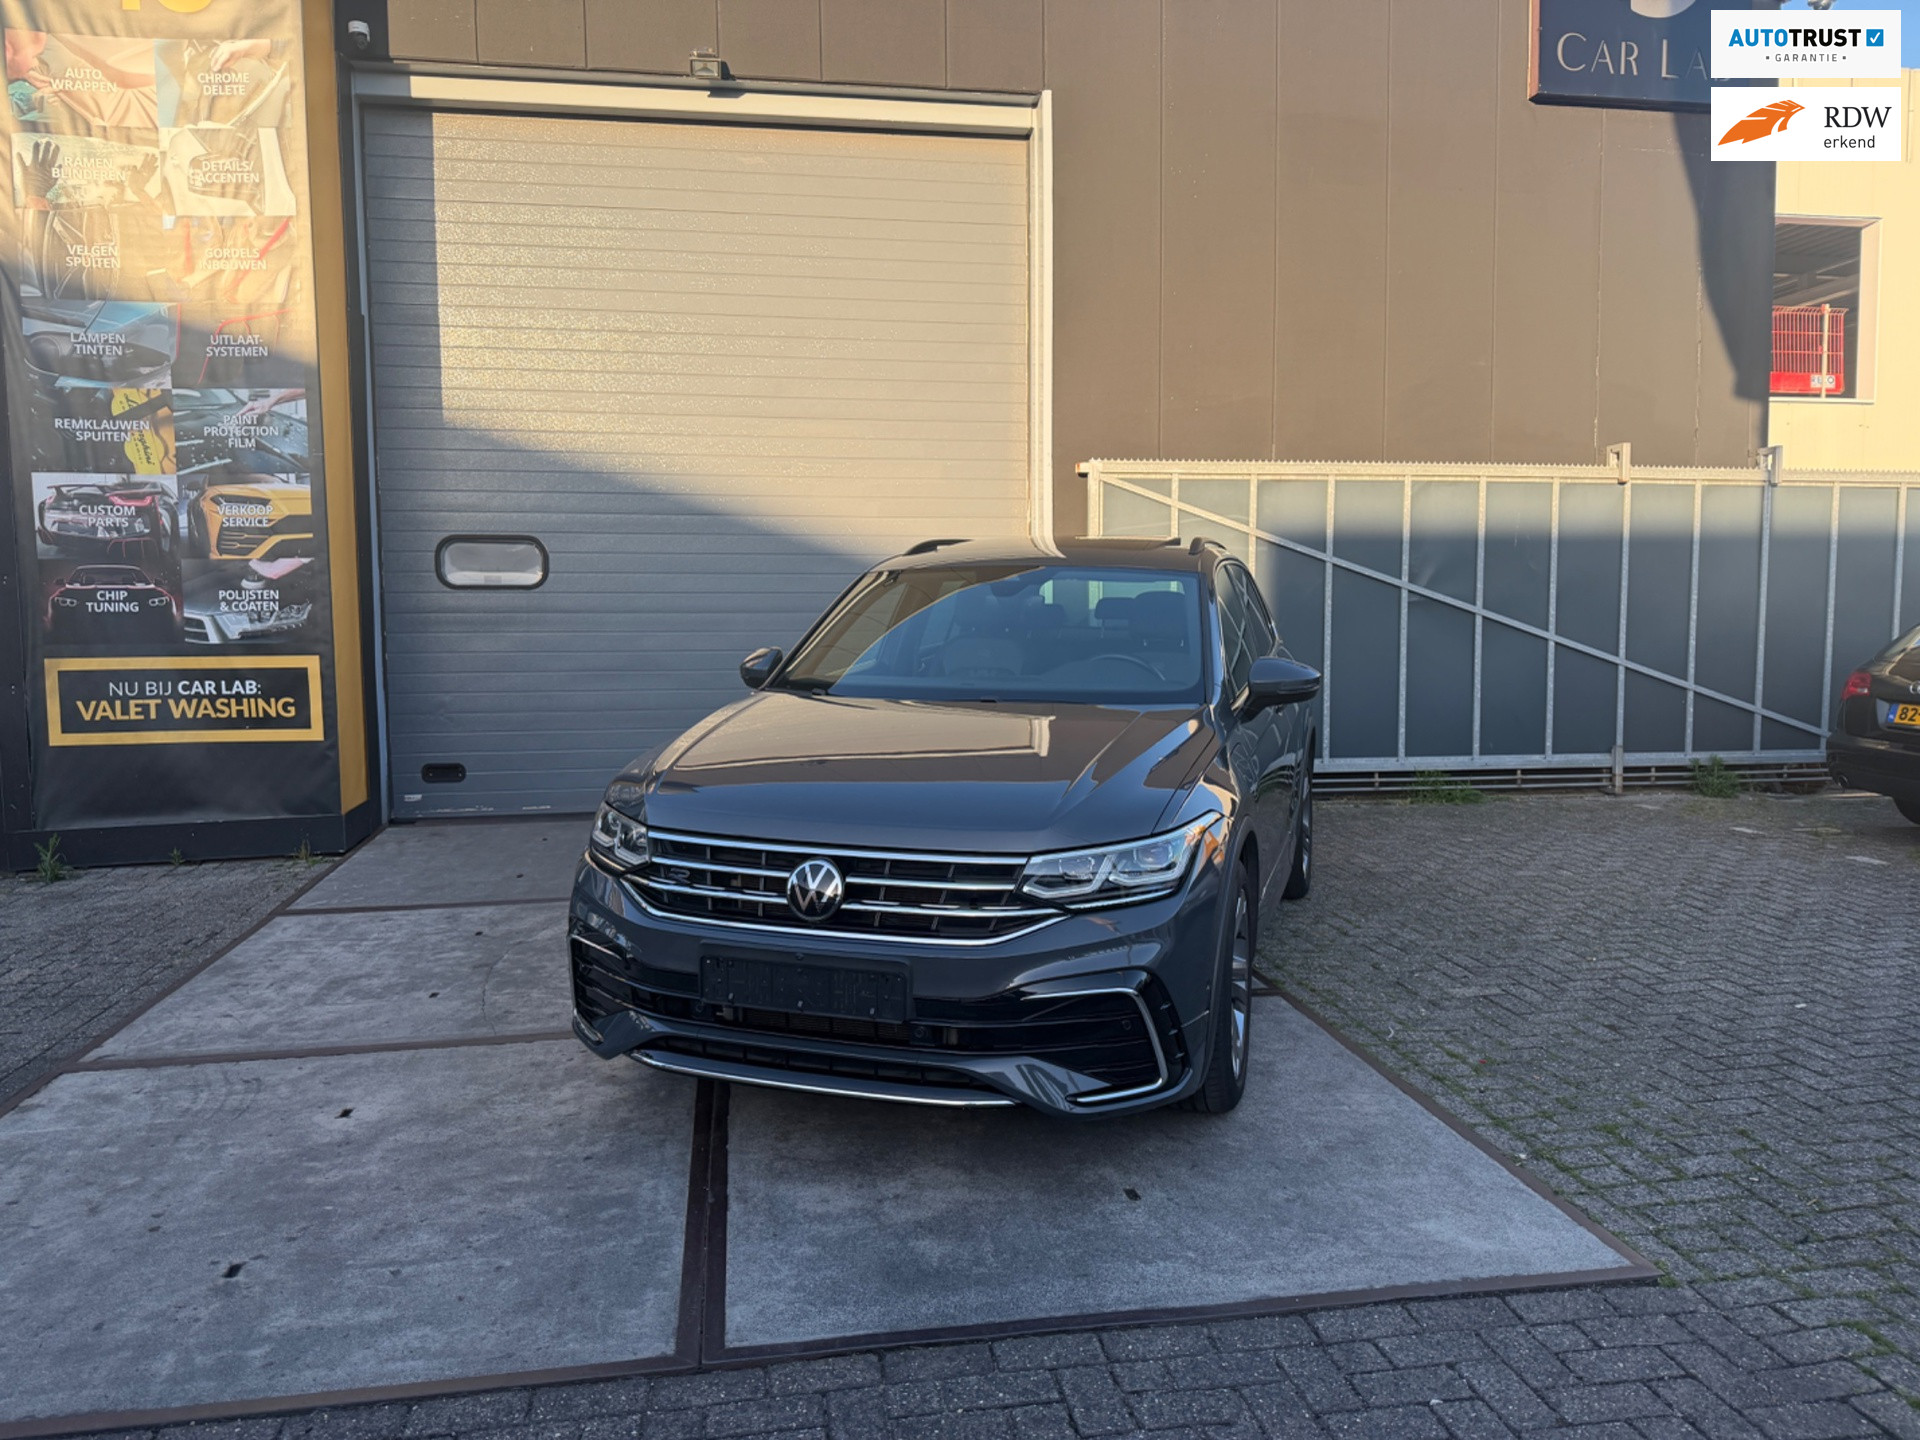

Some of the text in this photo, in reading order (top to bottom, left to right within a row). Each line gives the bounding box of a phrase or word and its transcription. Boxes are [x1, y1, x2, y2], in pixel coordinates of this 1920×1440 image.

[1661, 38, 1730, 81] LA
[65, 68, 102, 80] AUTO
[198, 73, 250, 84] CHROME
[50, 79, 117, 93] WRAPPEN
[203, 84, 246, 96] DELETE
[64, 156, 113, 168] RAMEN
[202, 160, 254, 172] DETAILS/
[51, 168, 126, 181] BLINDEREN
[199, 172, 260, 183] ACCENTEN
[67, 244, 118, 257] VELGEN
[204, 247, 260, 258] GORDELS
[65, 256, 121, 268] SPUITEN
[70, 332, 126, 344] LAMPEN
[210, 334, 264, 346] UITLAAT-
[74, 344, 123, 356] TINTEN
[206, 346, 268, 357] SYSTEMEN
[54, 418, 150, 430] REMKLAUWEN
[223, 415, 259, 426] PAINT
[75, 430, 131, 443] SPUITEN
[203, 426, 279, 437] PROTECTION
[228, 437, 256, 448] FILM
[79, 504, 136, 516] CUSTOM
[217, 504, 273, 516] VERKOOP
[88, 516, 129, 528] PARTS
[222, 516, 269, 528] SERVICE
[96, 590, 128, 601] CHIP
[218, 589, 280, 602] POLIJSTEN
[85, 601, 140, 613] TUNING
[219, 601, 280, 612] & COATEN
[109, 680, 262, 697] NU BIJ CAR LAB:
[76, 697, 297, 721] VALET WASHING
